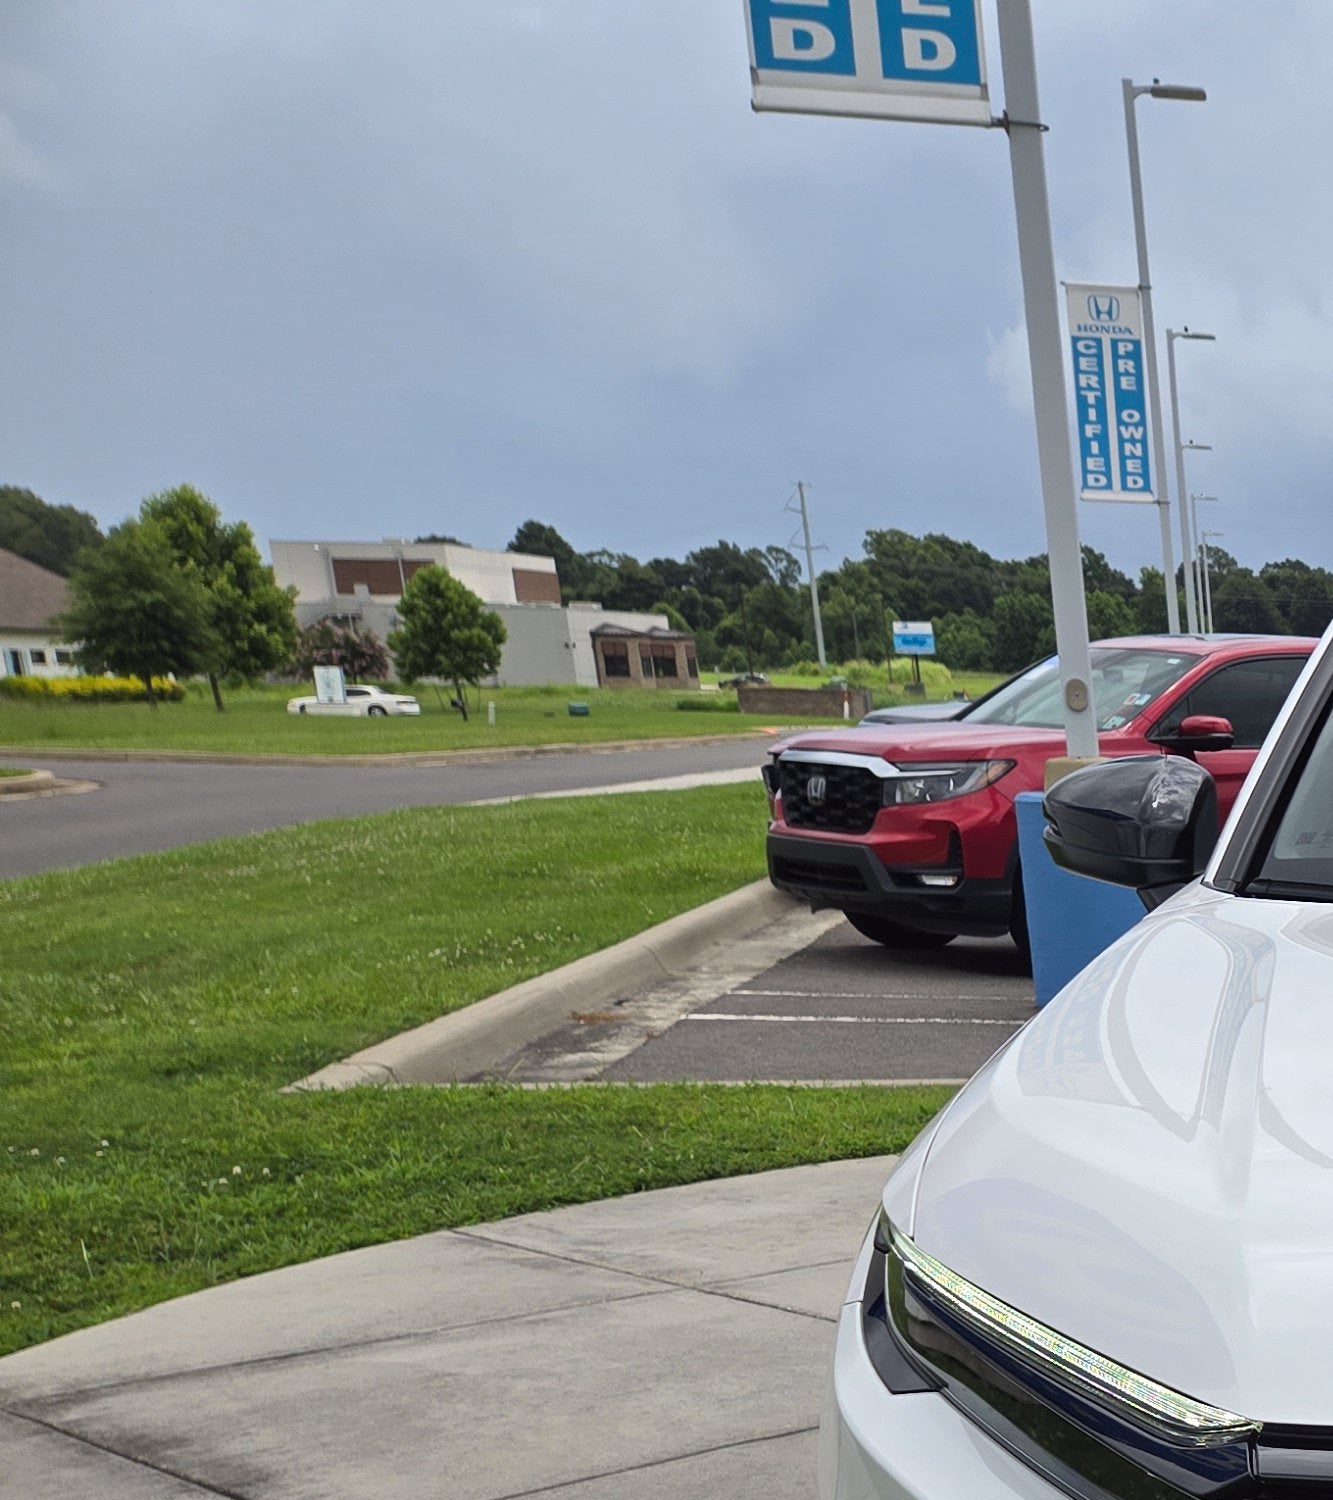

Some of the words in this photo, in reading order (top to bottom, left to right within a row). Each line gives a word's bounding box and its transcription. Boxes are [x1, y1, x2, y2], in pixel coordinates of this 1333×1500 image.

[769, 0, 836, 61] D
[1076, 323, 1134, 335] HONDA
[1117, 341, 1137, 391] PRE
[1076, 339, 1108, 487] CERTIFIED
[1119, 409, 1144, 489] OWNED
